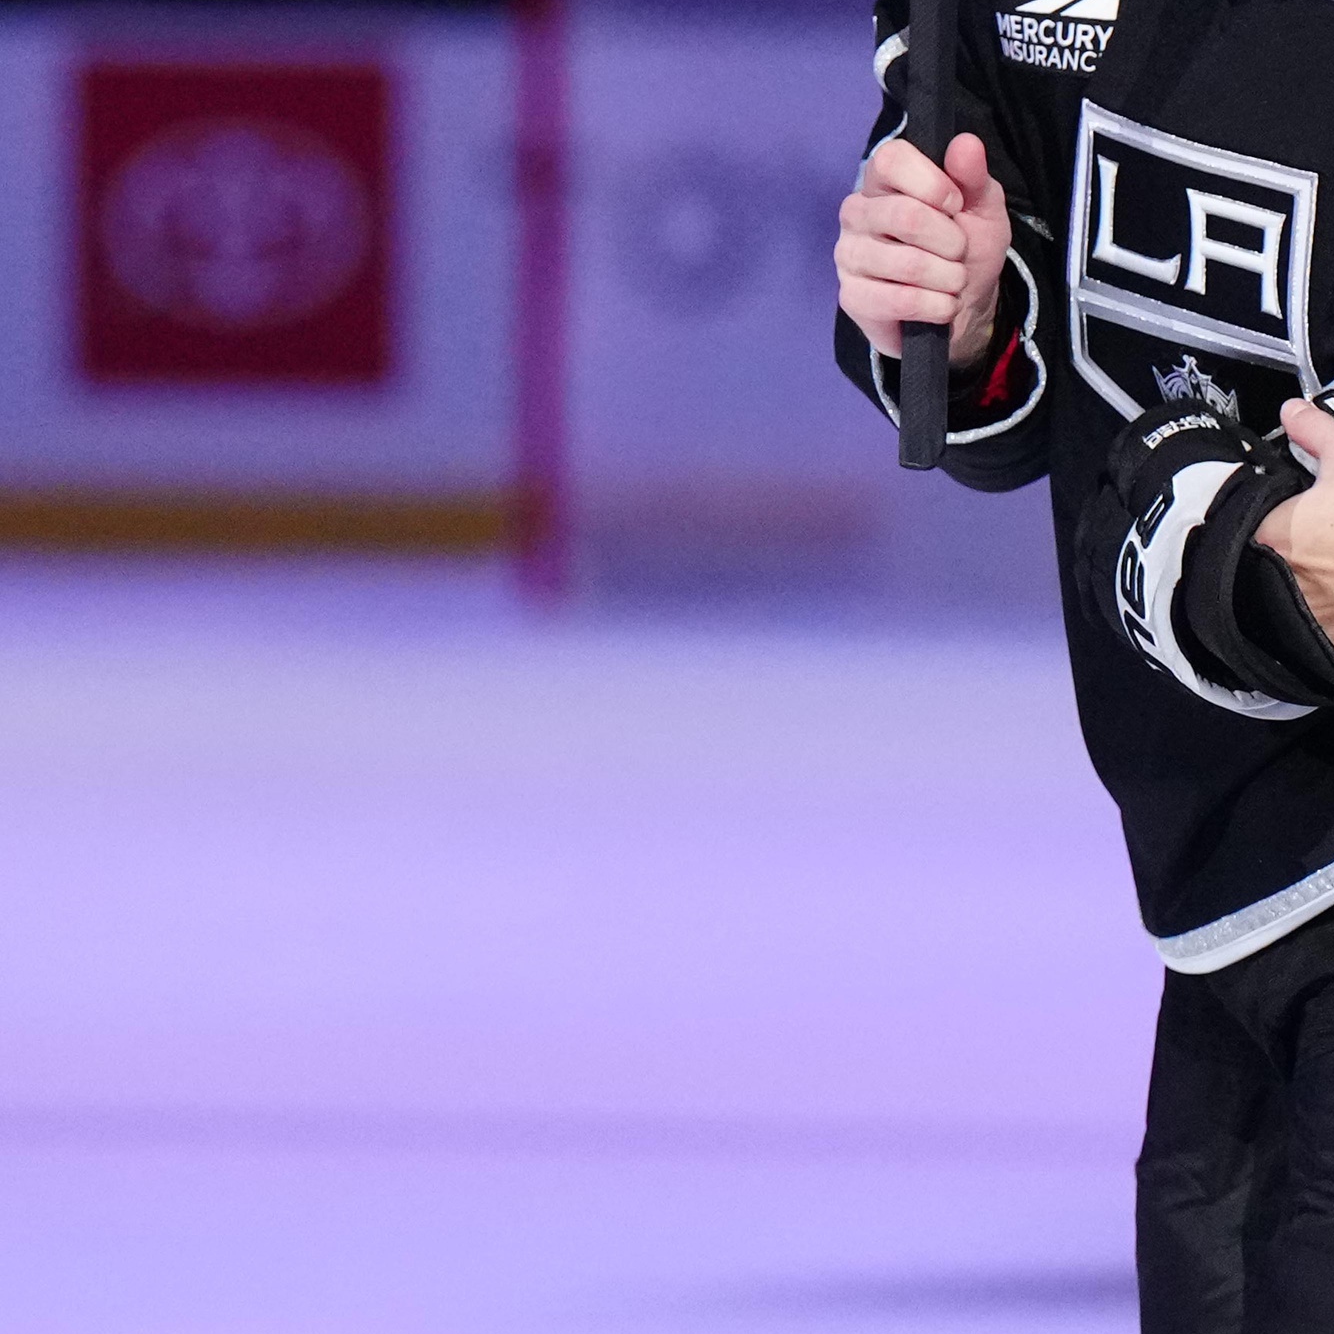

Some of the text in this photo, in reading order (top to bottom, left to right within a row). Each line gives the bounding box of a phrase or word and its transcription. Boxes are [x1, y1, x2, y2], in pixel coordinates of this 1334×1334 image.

[995, 11, 1114, 52] MERCURY
[1000, 36, 1102, 73] INSURANC
[1092, 154, 1287, 320] LA
